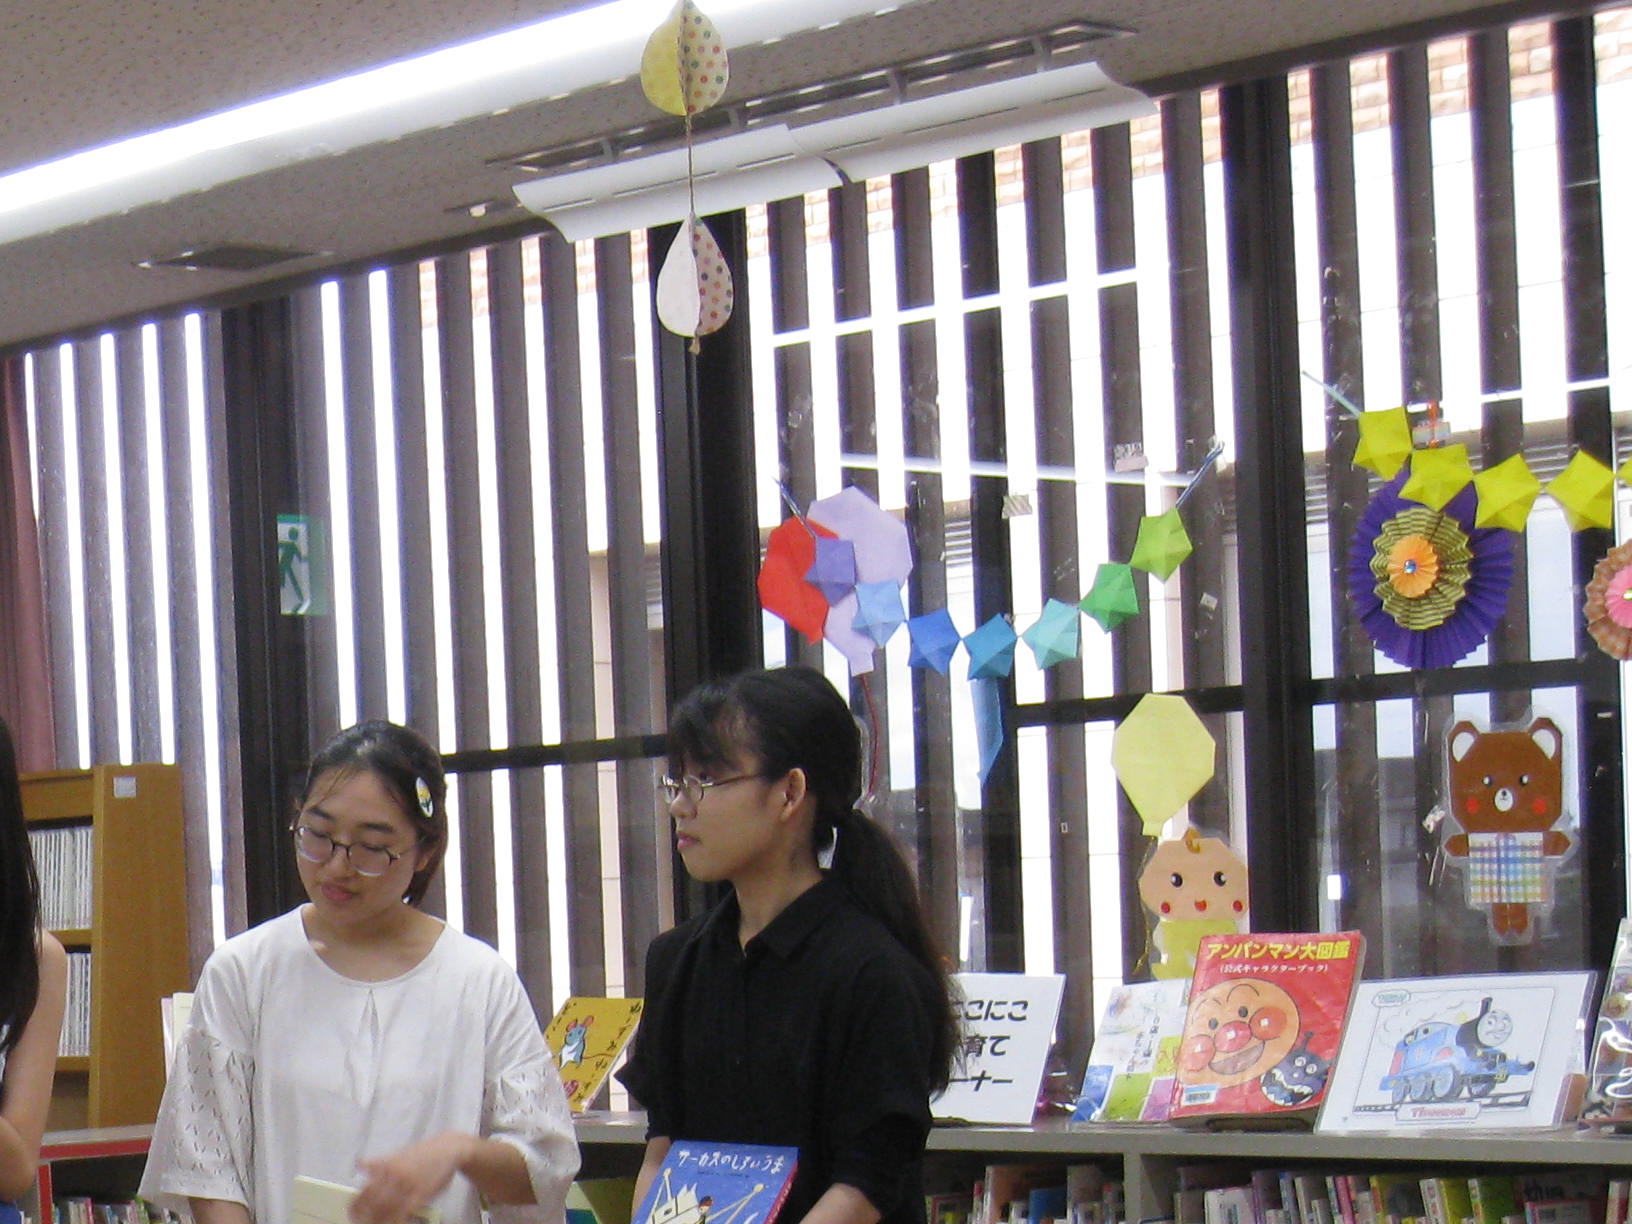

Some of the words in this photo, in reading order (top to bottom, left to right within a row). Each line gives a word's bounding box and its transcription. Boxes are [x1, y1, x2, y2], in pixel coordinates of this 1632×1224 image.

[1205, 939, 1352, 960] アンパンマン大図鑑
